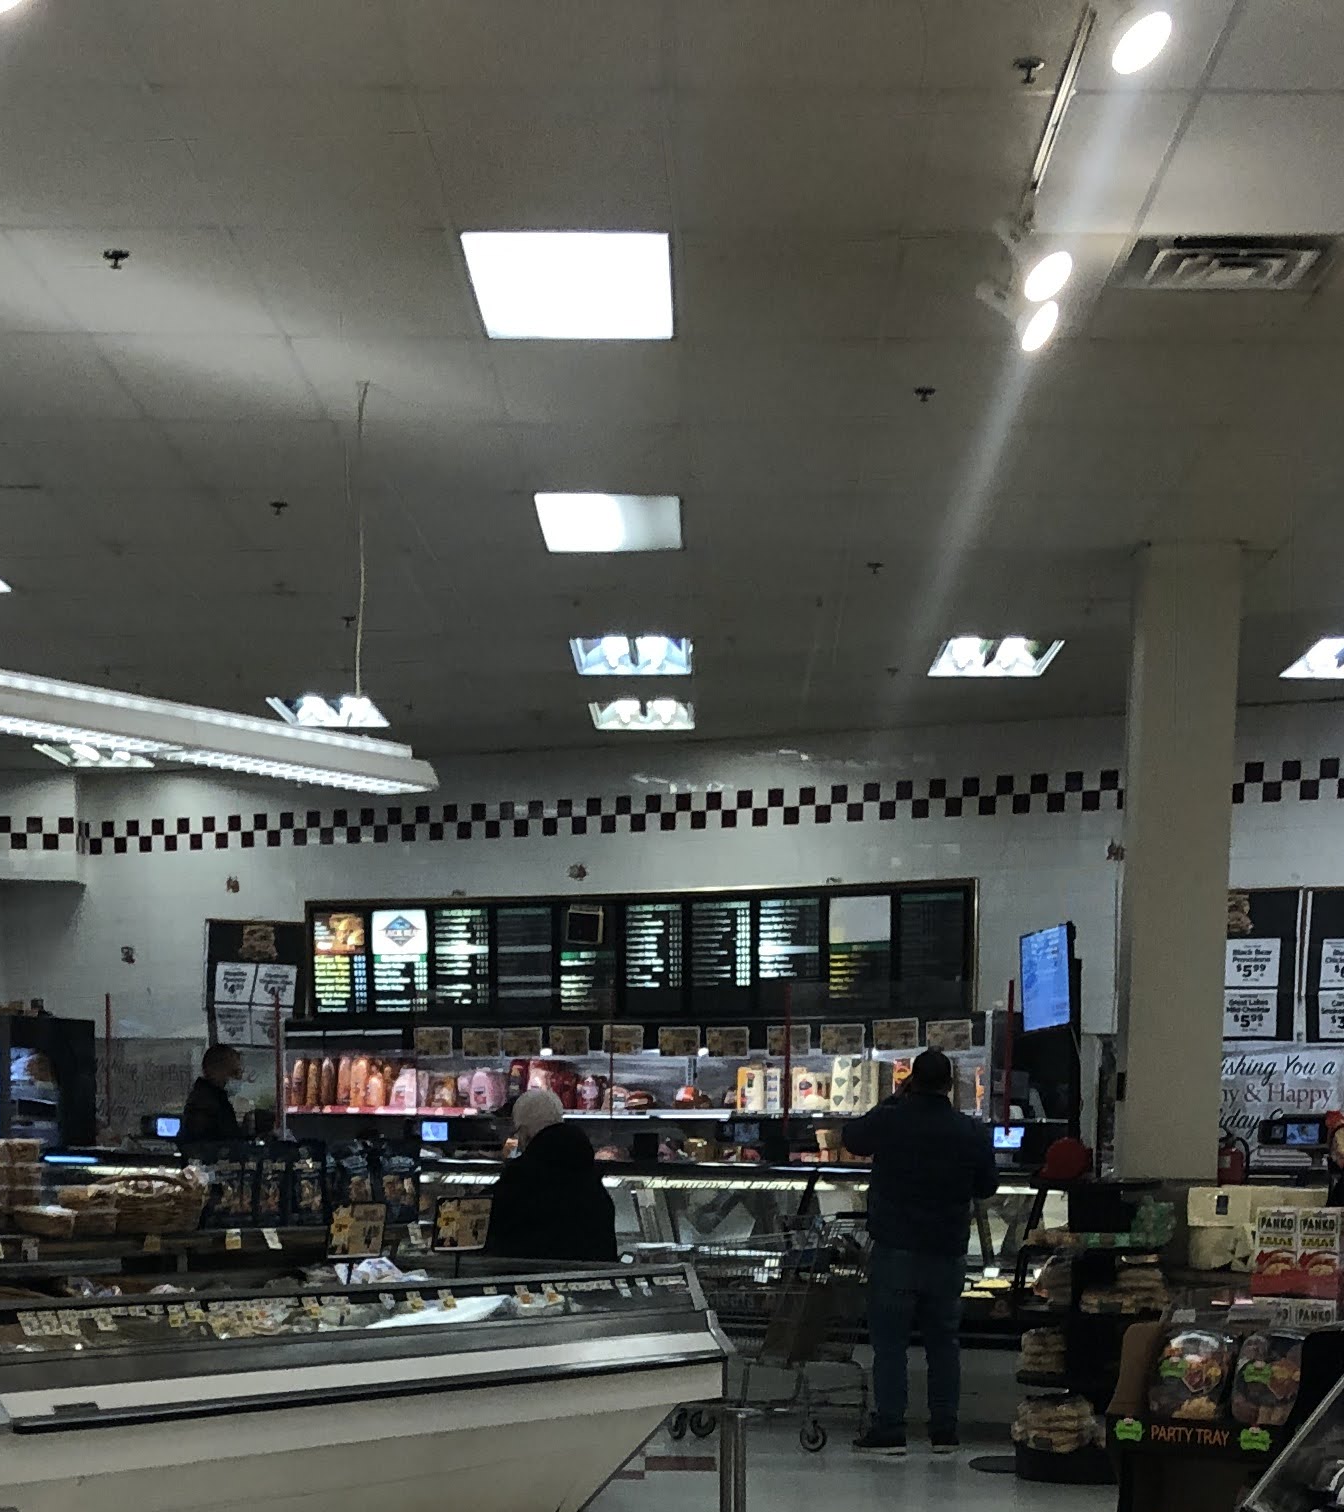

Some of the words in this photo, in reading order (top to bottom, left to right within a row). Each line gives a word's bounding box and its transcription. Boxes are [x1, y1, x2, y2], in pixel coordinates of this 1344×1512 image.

[1221, 1054, 1277, 1087] ishing
[1284, 1054, 1317, 1075] You
[1322, 1061, 1336, 1075] a
[1244, 1082, 1262, 1103] &
[1268, 1082, 1334, 1110] Happy
[1219, 1108, 1260, 1139] iday
[1261, 1216, 1294, 1231] PANKO
[1302, 1217, 1335, 1232] PANKO
[1299, 1308, 1331, 1321] PANKO
[1150, 1424, 1194, 1443] PARTY
[1195, 1428, 1230, 1447] TRAY
